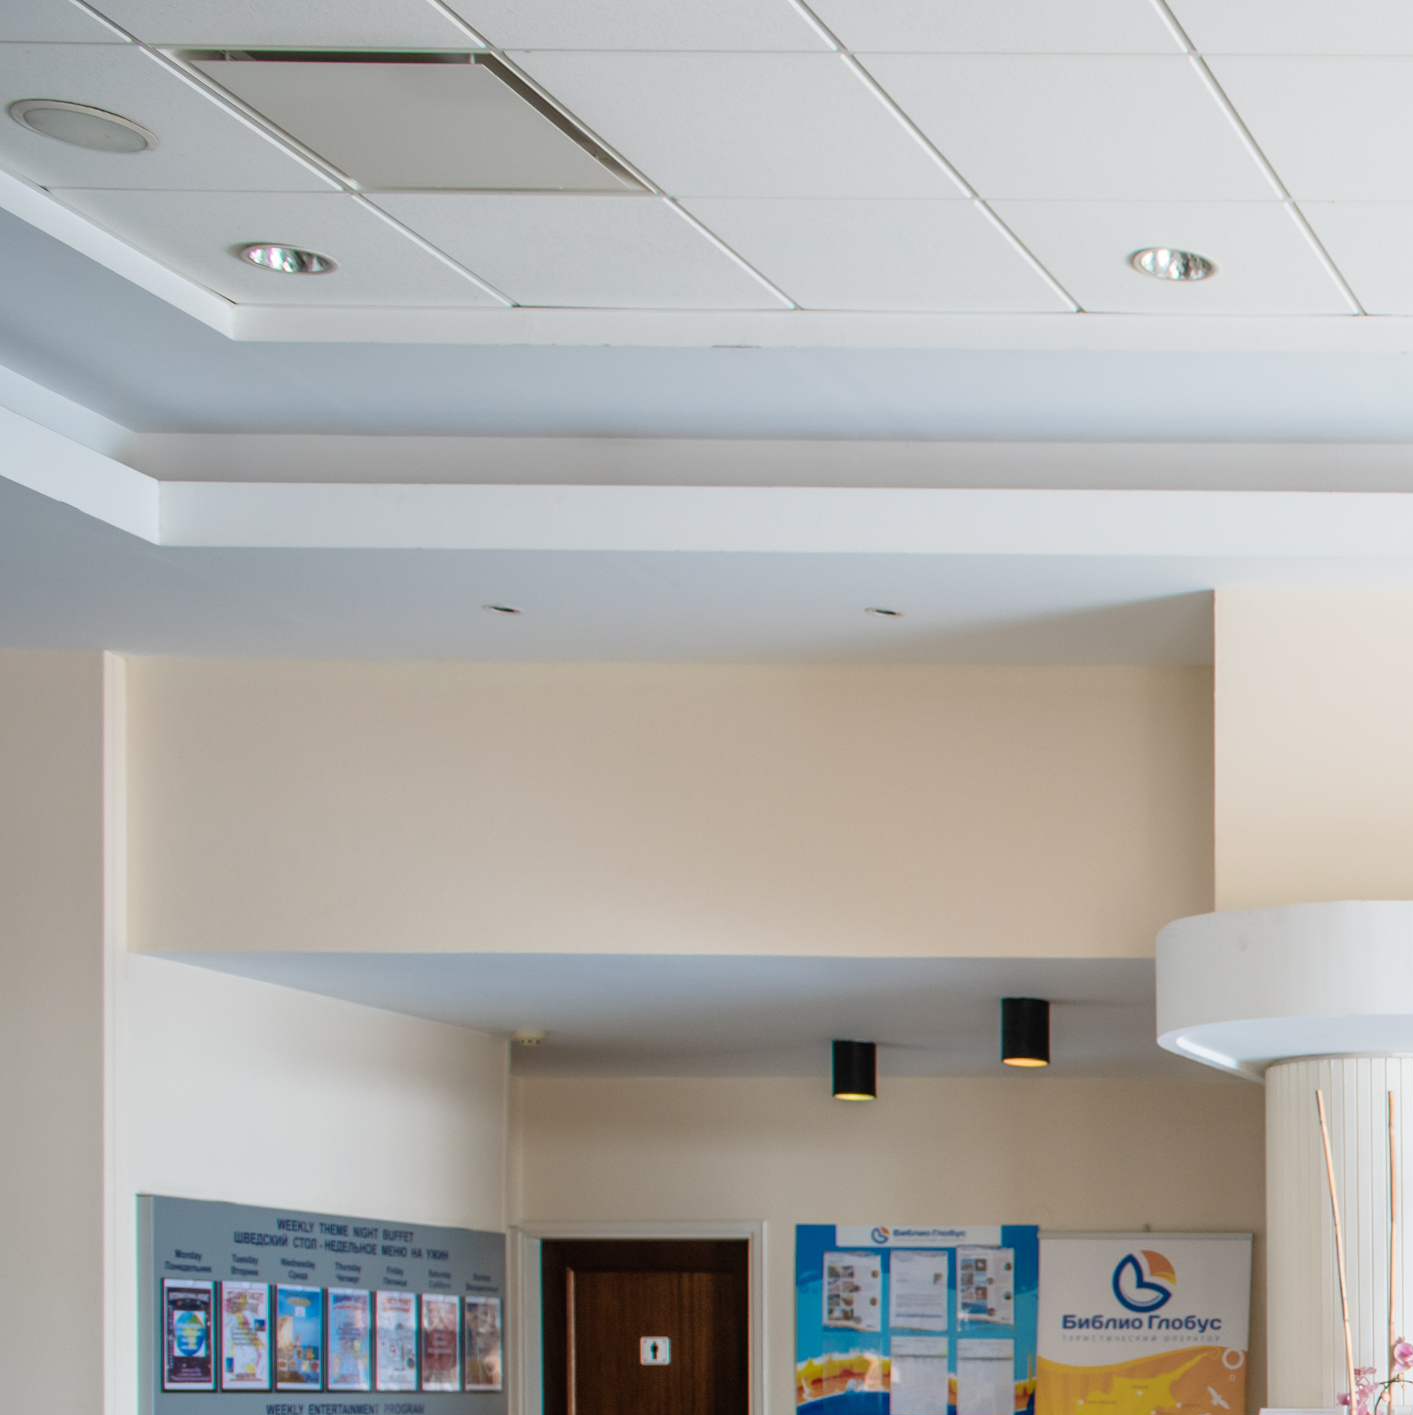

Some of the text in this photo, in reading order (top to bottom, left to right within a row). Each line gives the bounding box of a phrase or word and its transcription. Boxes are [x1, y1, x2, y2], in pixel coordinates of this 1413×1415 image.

[276, 1218, 414, 1243] WEEKLY THEME NIGHT BUFFET
[893, 1229, 967, 1239] Библио Глобус
[233, 1231, 289, 1247] ШВЕДСКИЙ
[293, 1236, 317, 1250] СТОЛ
[381, 1245, 407, 1258] МЕНЮ
[411, 1249, 423, 1259] НА
[426, 1249, 449, 1260] УЖИН
[175, 1249, 203, 1262] Monday
[232, 1253, 259, 1266] Tuesday
[280, 1258, 315, 1270] Wednesday
[335, 1261, 361, 1273] Thursday
[288, 1269, 309, 1280] Среда
[386, 1265, 404, 1277] Friday
[1061, 1314, 1222, 1334] Библио Глобус
[266, 1403, 425, 1415] WEEKLY ENTERTAINMENT PROGRAM
